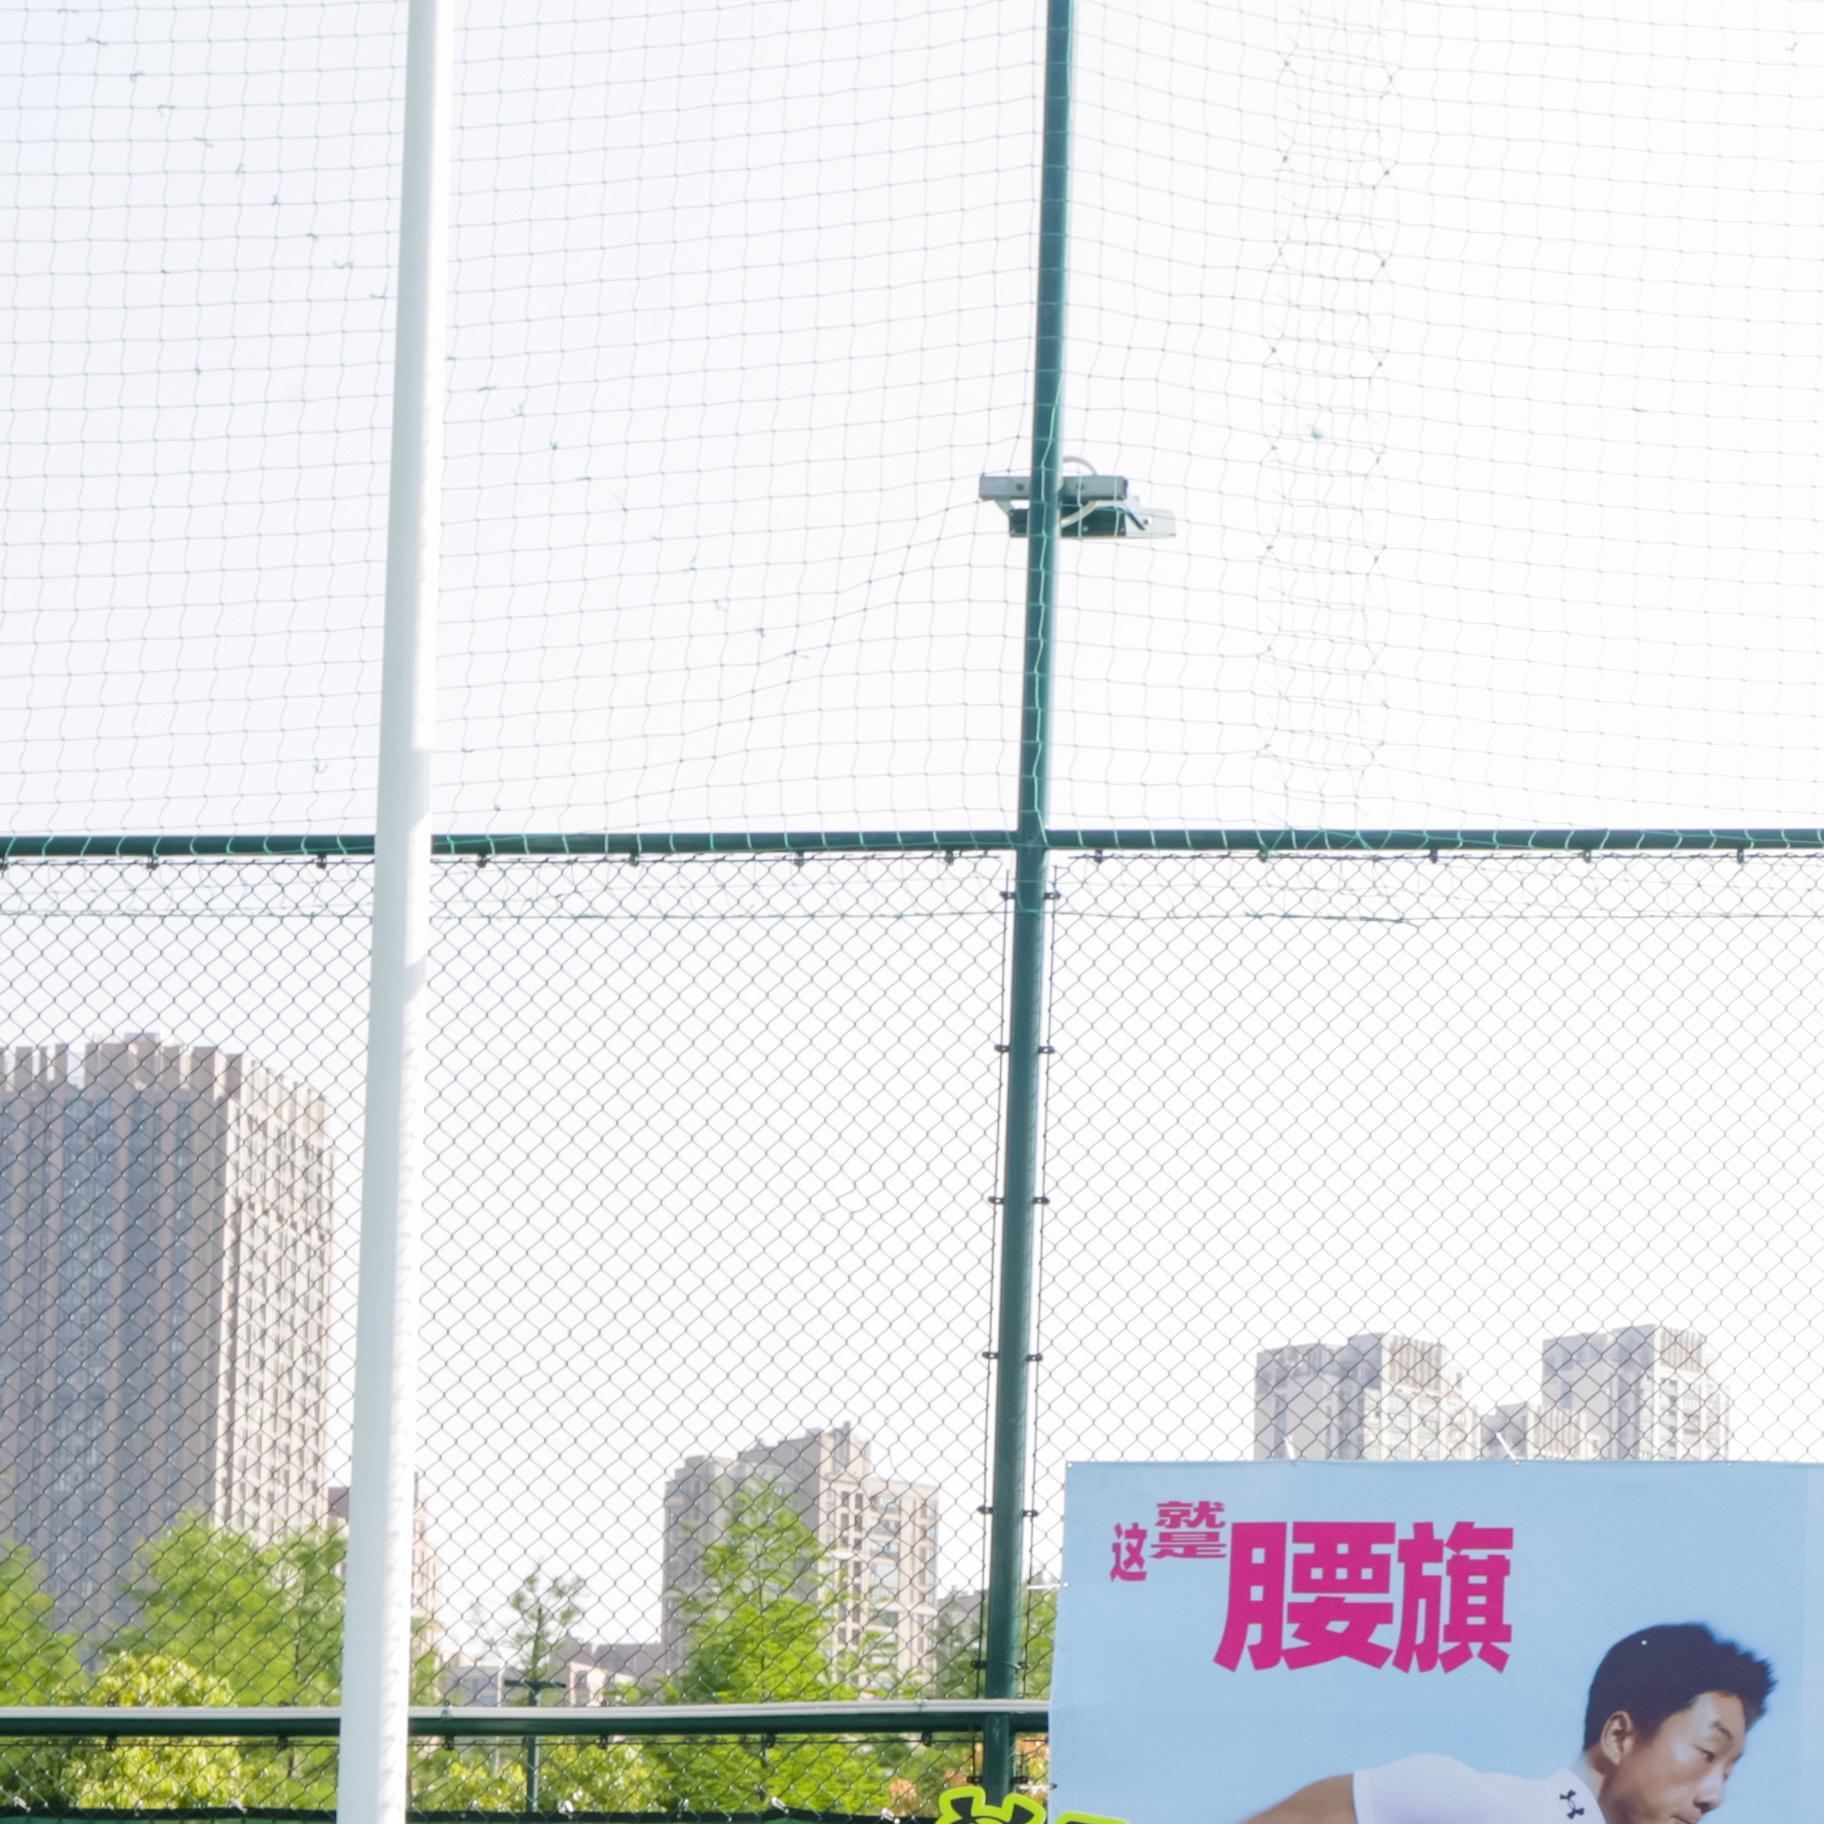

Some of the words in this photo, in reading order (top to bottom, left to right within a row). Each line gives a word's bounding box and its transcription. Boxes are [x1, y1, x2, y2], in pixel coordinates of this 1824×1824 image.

[1110, 1500, 1514, 1674] 这就是腰旗
